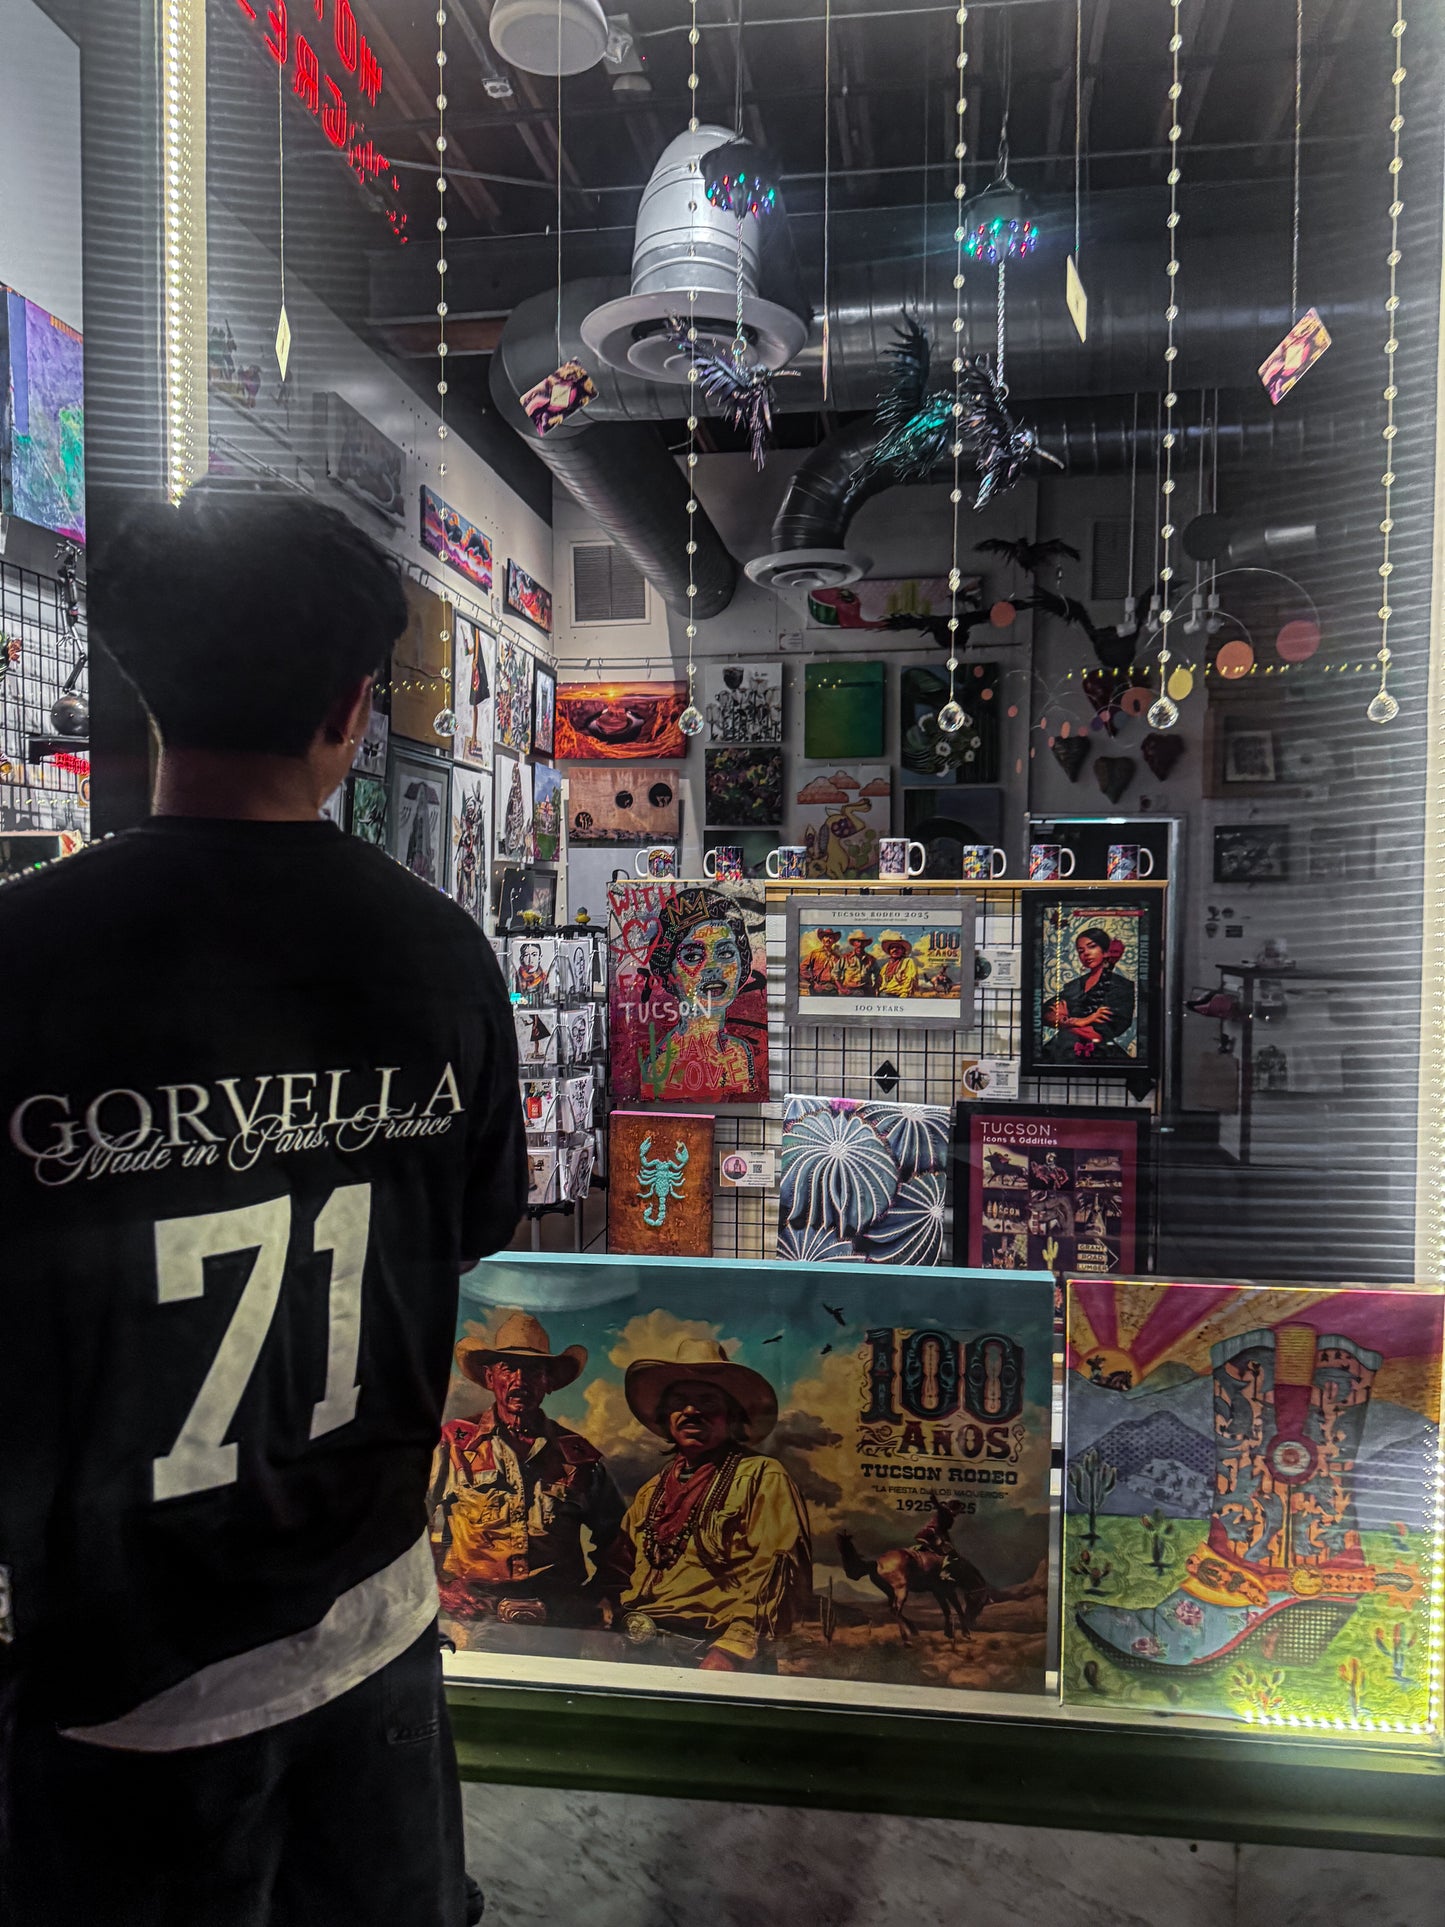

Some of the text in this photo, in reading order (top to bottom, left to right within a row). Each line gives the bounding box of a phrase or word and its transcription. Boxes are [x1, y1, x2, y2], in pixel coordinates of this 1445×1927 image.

[608, 883, 680, 917] WITH
[904, 911, 930, 920] 2025
[927, 931, 961, 951] 100
[618, 990, 713, 1025] TUCSON
[671, 1030, 735, 1059] MAKE
[664, 1057, 750, 1092] LOVE
[9, 1061, 466, 1160] GORVELLA
[34, 1127, 173, 1186] Made
[181, 1139, 220, 1168] in
[335, 1103, 453, 1153] France
[1019, 1137, 1058, 1145] Oddities
[152, 1182, 372, 1503] 71
[860, 1327, 1025, 1425] 100
[860, 1463, 1018, 1485] TUCSON RODEO
[889, 1485, 918, 1495] FIESTA
